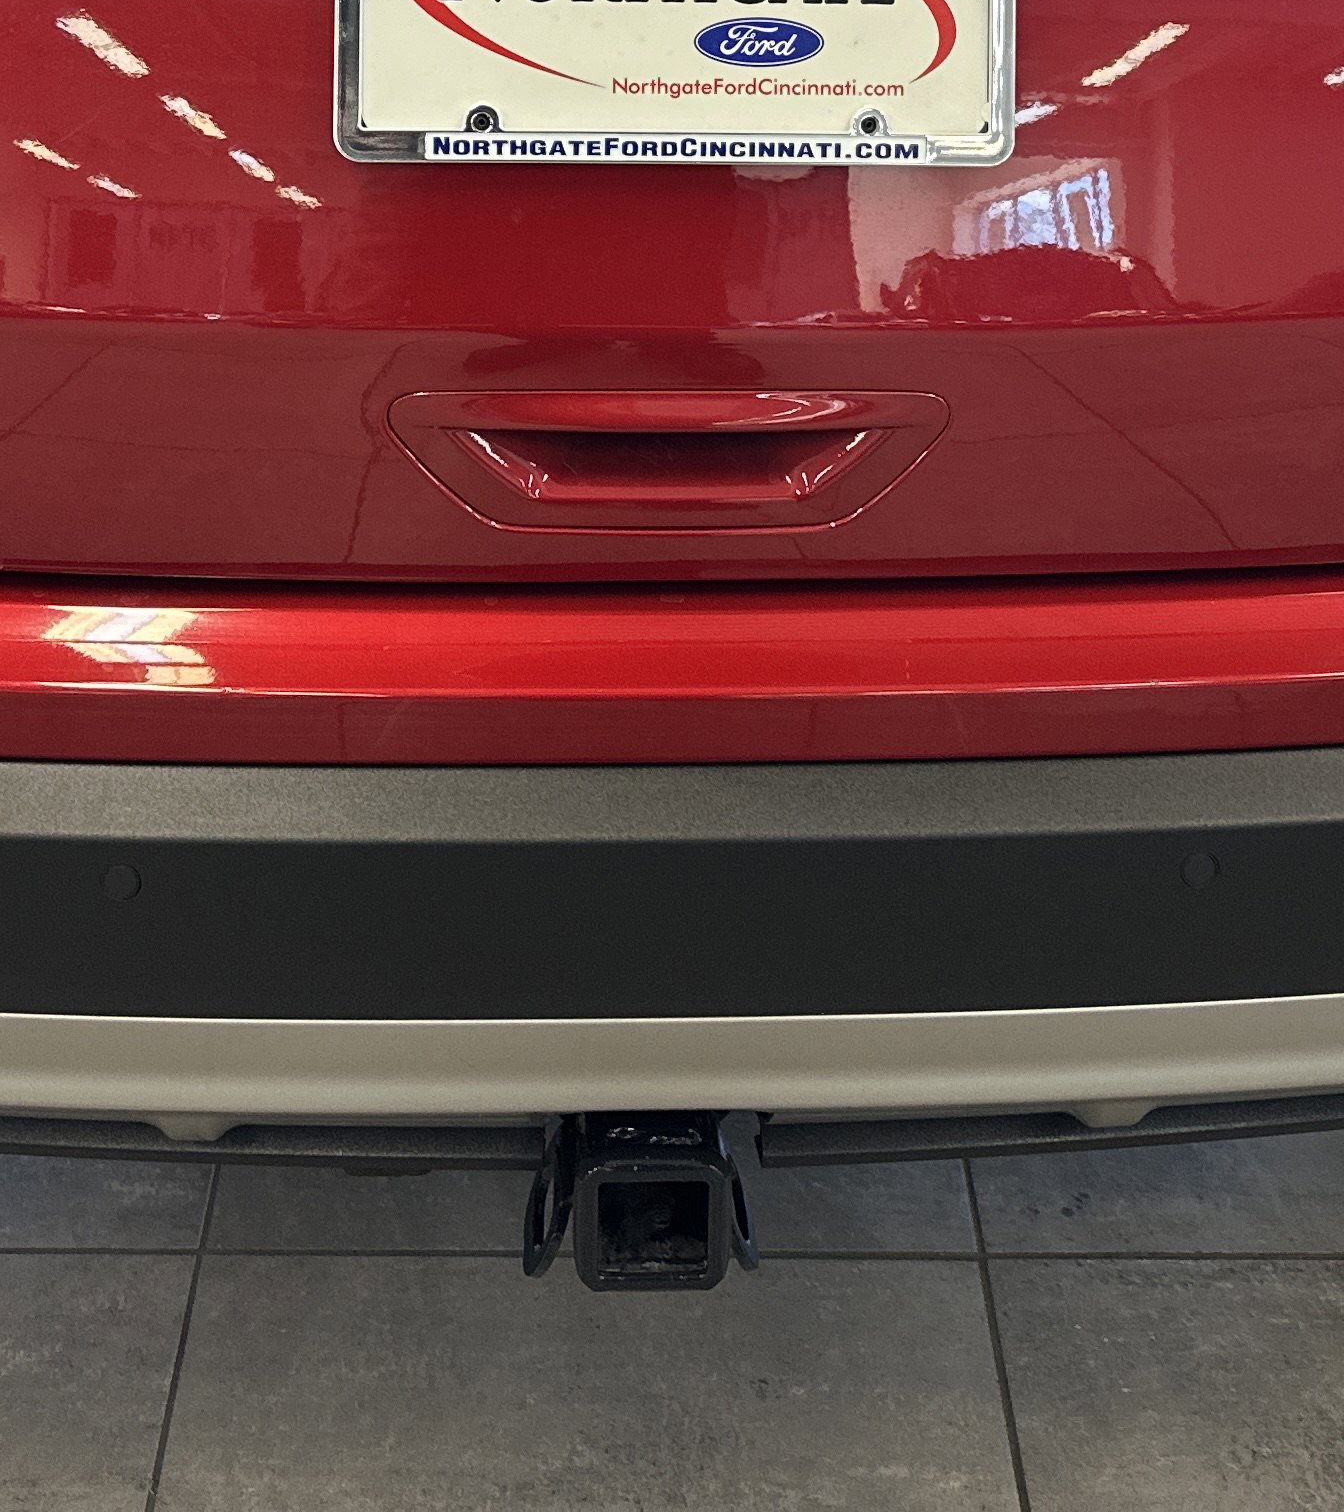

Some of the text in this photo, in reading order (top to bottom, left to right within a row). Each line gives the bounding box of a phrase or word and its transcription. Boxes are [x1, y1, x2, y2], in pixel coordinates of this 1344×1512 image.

[719, 24, 798, 57] Ford
[612, 77, 905, 99] NorthgateFordCincinnati.com
[432, 137, 920, 160] NORTHGATEFORDCINCINNATI.COM
